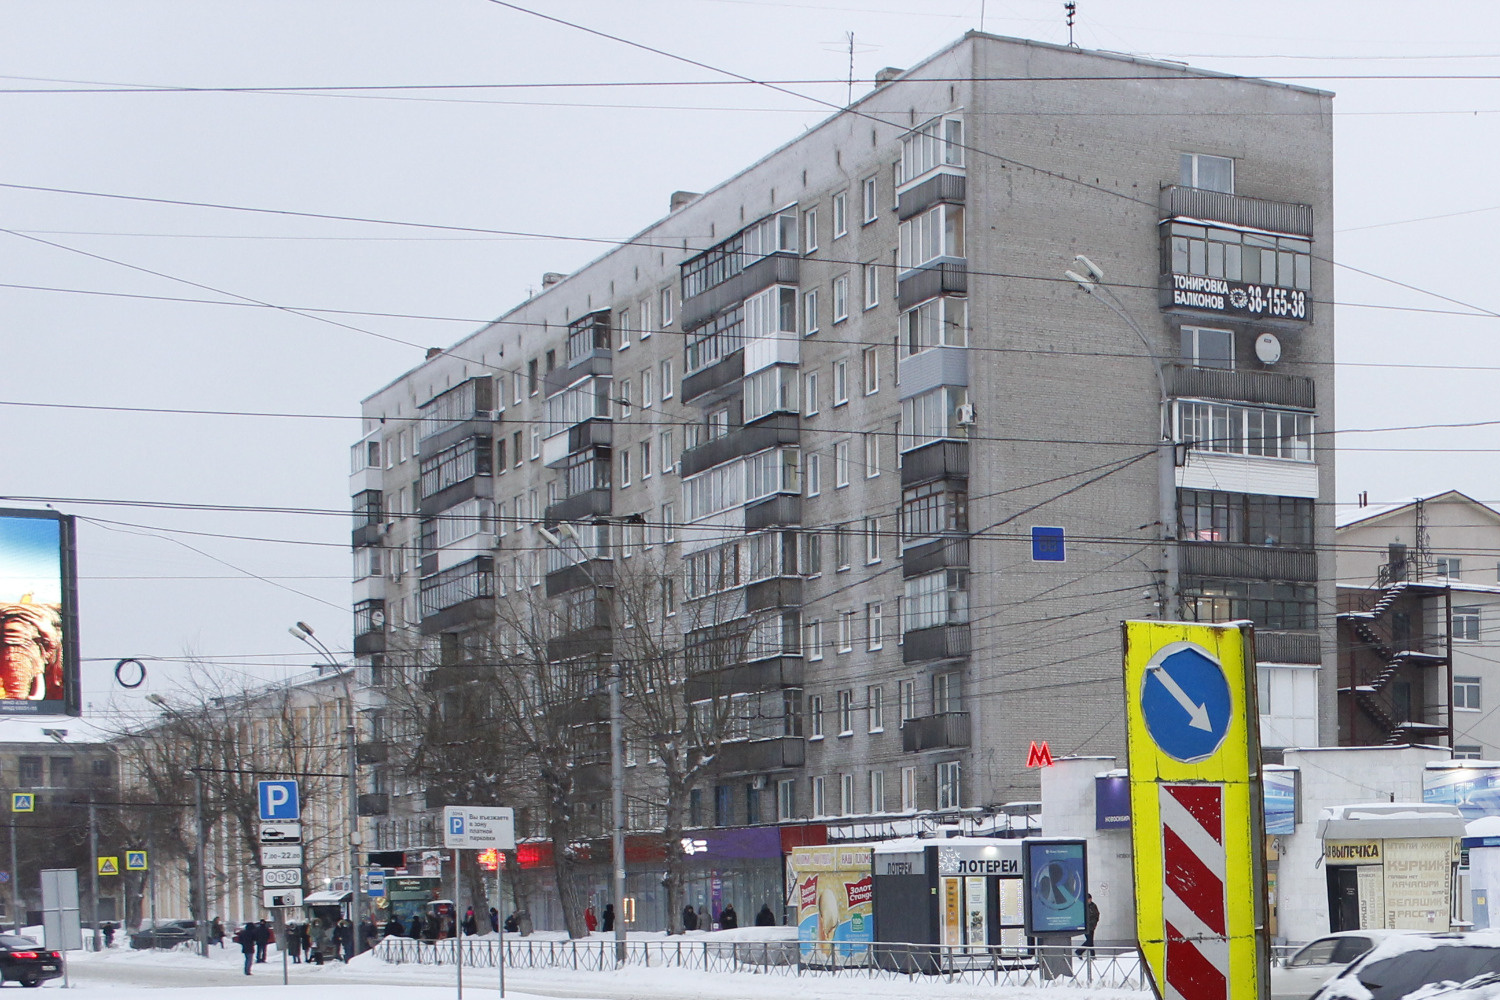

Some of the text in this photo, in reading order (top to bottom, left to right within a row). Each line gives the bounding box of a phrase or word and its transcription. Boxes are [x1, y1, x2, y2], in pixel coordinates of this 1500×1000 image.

[1173, 274, 1229, 295] ТОНИРОВКА
[1174, 290, 1225, 310] БАЛКОНОВ
[1248, 284, 1305, 319] 38-155-38
[1332, 845, 1379, 858] ВЫПЕЧКА
[887, 862, 913, 875] ЛОТЕРЕИ
[958, 860, 1018, 873] ЛОТЕРЕИ
[1387, 861, 1444, 871] КУРНИК
